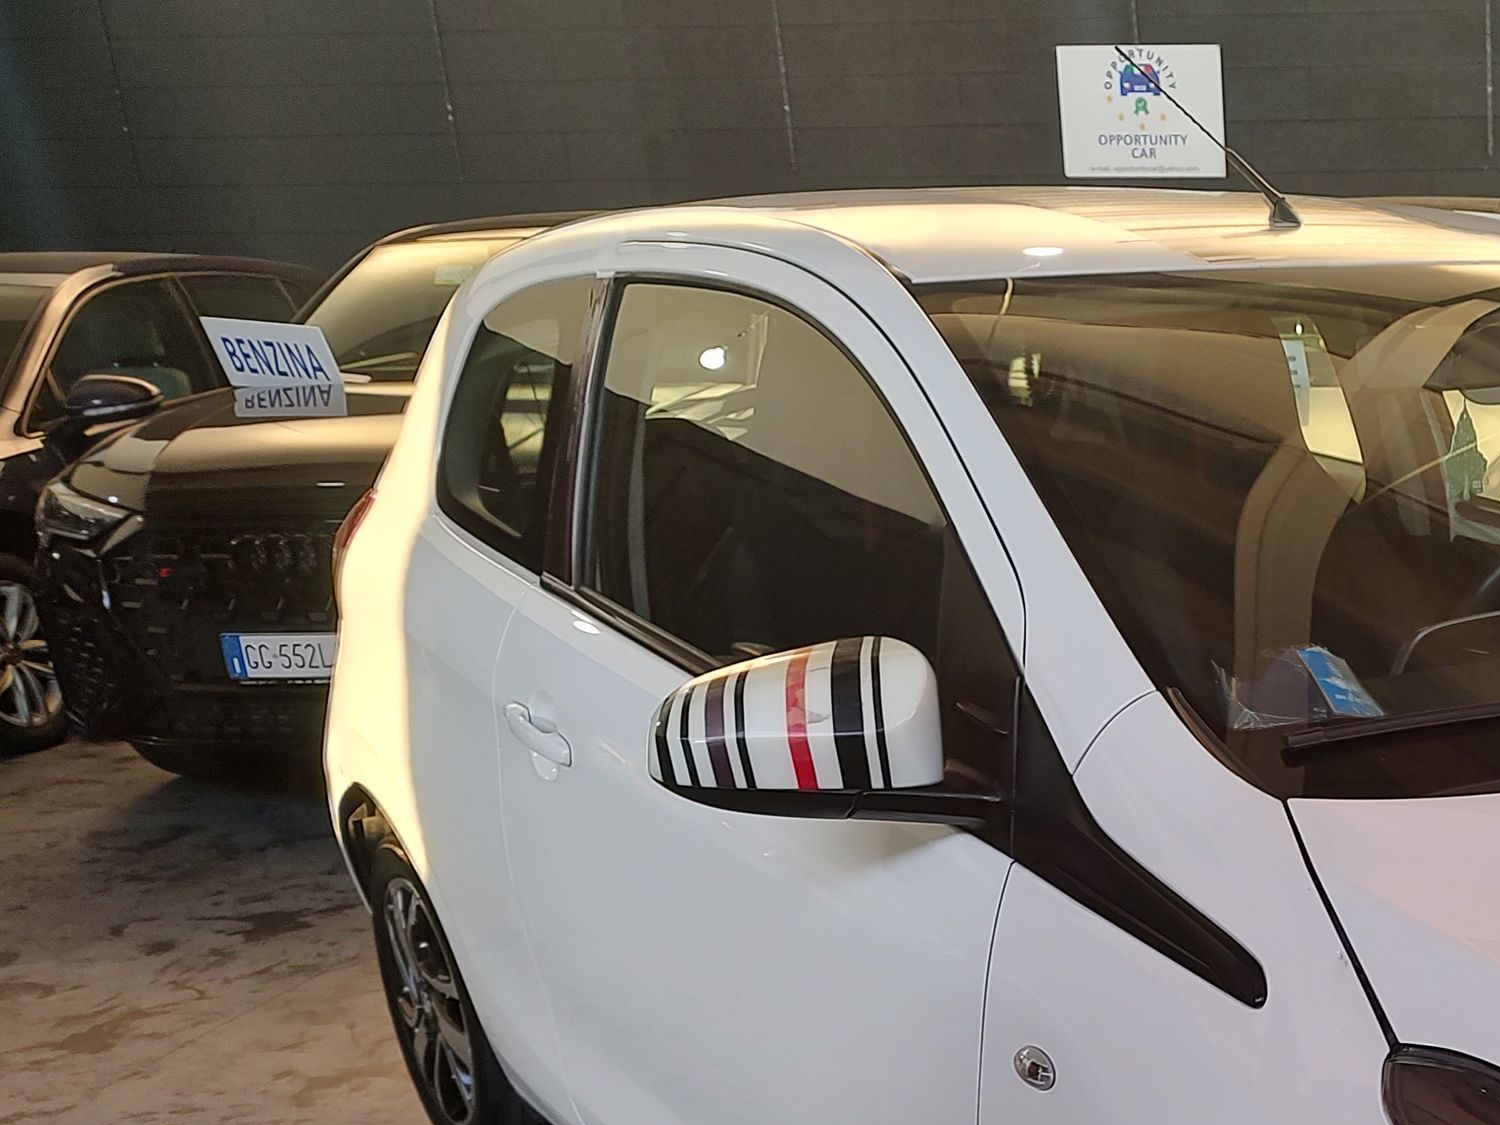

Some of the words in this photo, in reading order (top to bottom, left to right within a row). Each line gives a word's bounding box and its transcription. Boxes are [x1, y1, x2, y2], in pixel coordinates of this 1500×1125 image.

[1098, 134, 1188, 146] OPPORTUNITY
[1131, 147, 1157, 159] CAR
[220, 336, 331, 381] BENZINA
